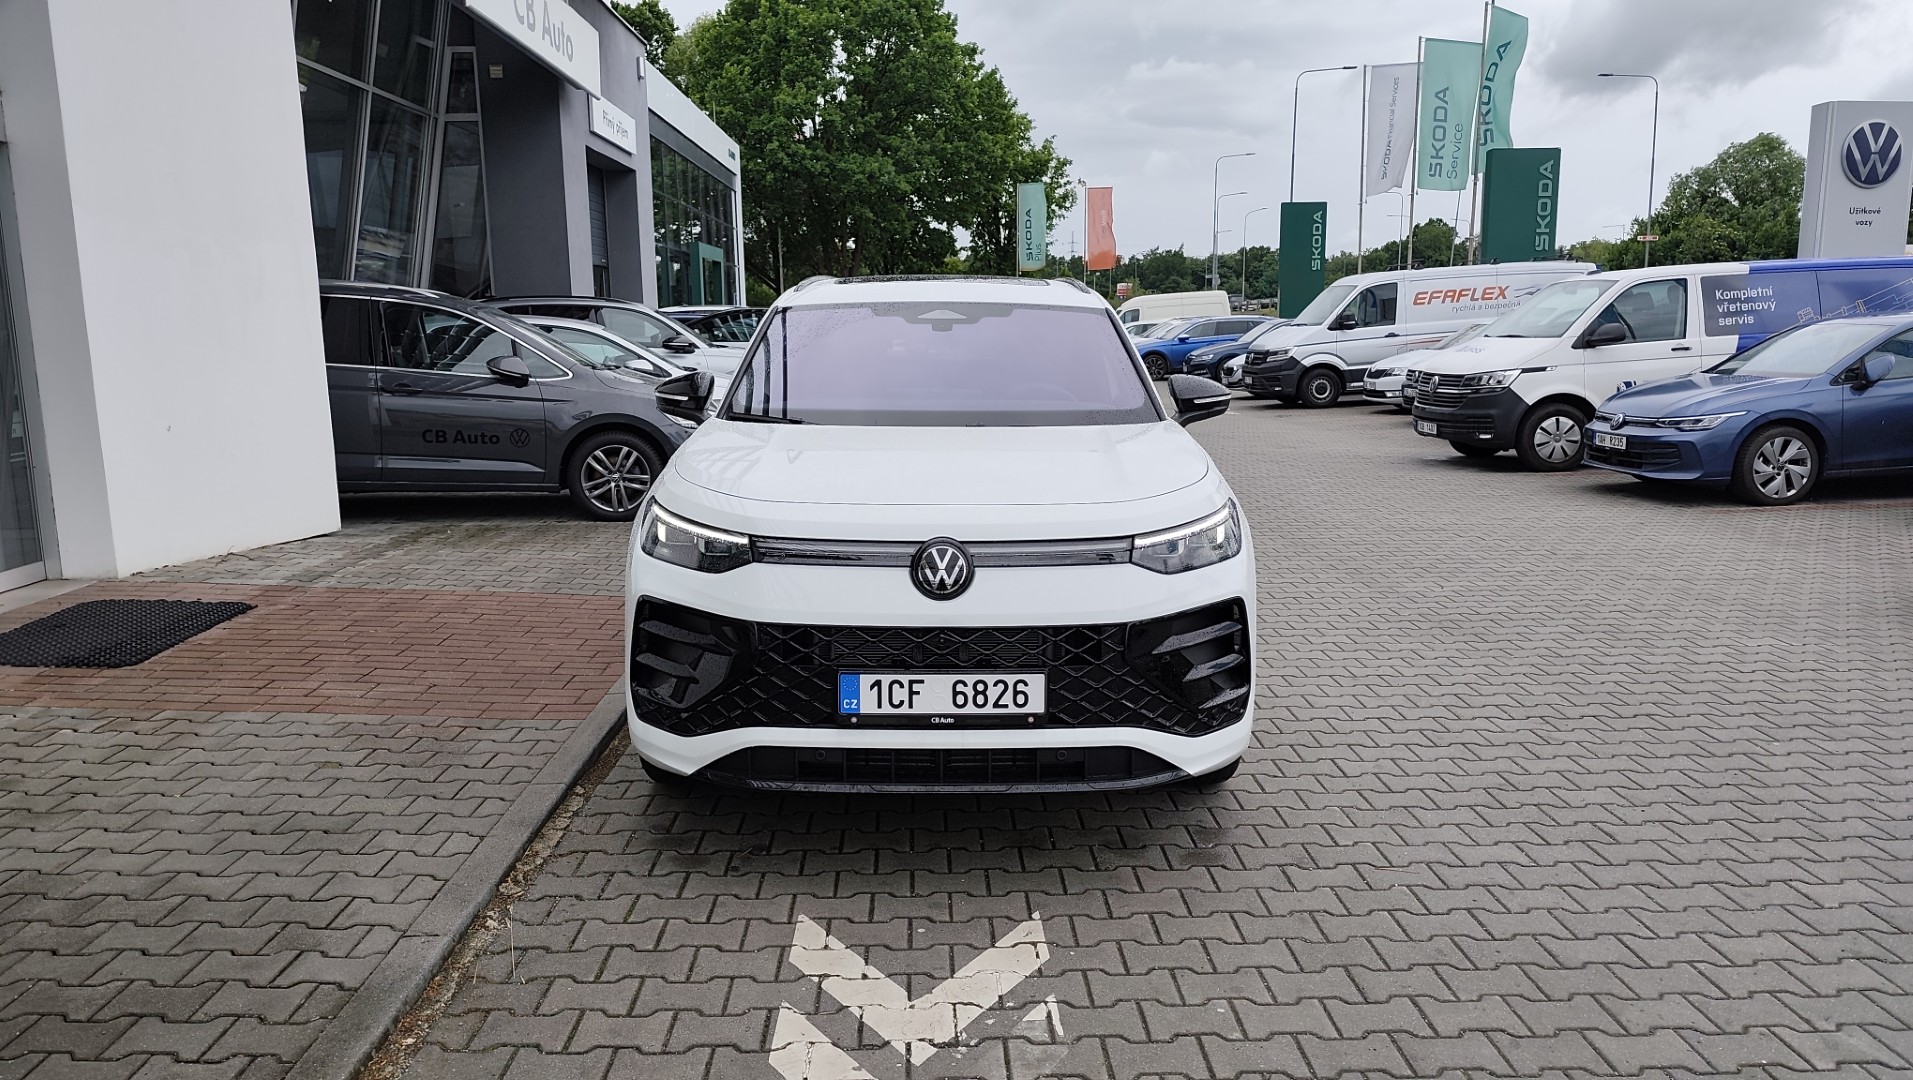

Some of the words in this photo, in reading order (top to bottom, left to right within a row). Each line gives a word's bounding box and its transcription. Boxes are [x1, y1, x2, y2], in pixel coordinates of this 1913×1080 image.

[542, 0, 574, 62] Auto
[1390, 76, 1400, 107] Services
[1447, 123, 1464, 180] Service
[1849, 207, 1881, 215] Užitkové
[1412, 285, 1510, 306] EFAFLEX
[1715, 285, 1773, 300] Kompletní
[1717, 298, 1776, 312] vřetenový
[1718, 314, 1754, 326] servis
[421, 429, 448, 444] CB
[453, 429, 501, 445] Auto
[869, 679, 925, 709] 1CF
[952, 679, 1029, 709] 6826
[843, 699, 858, 709] CZ
